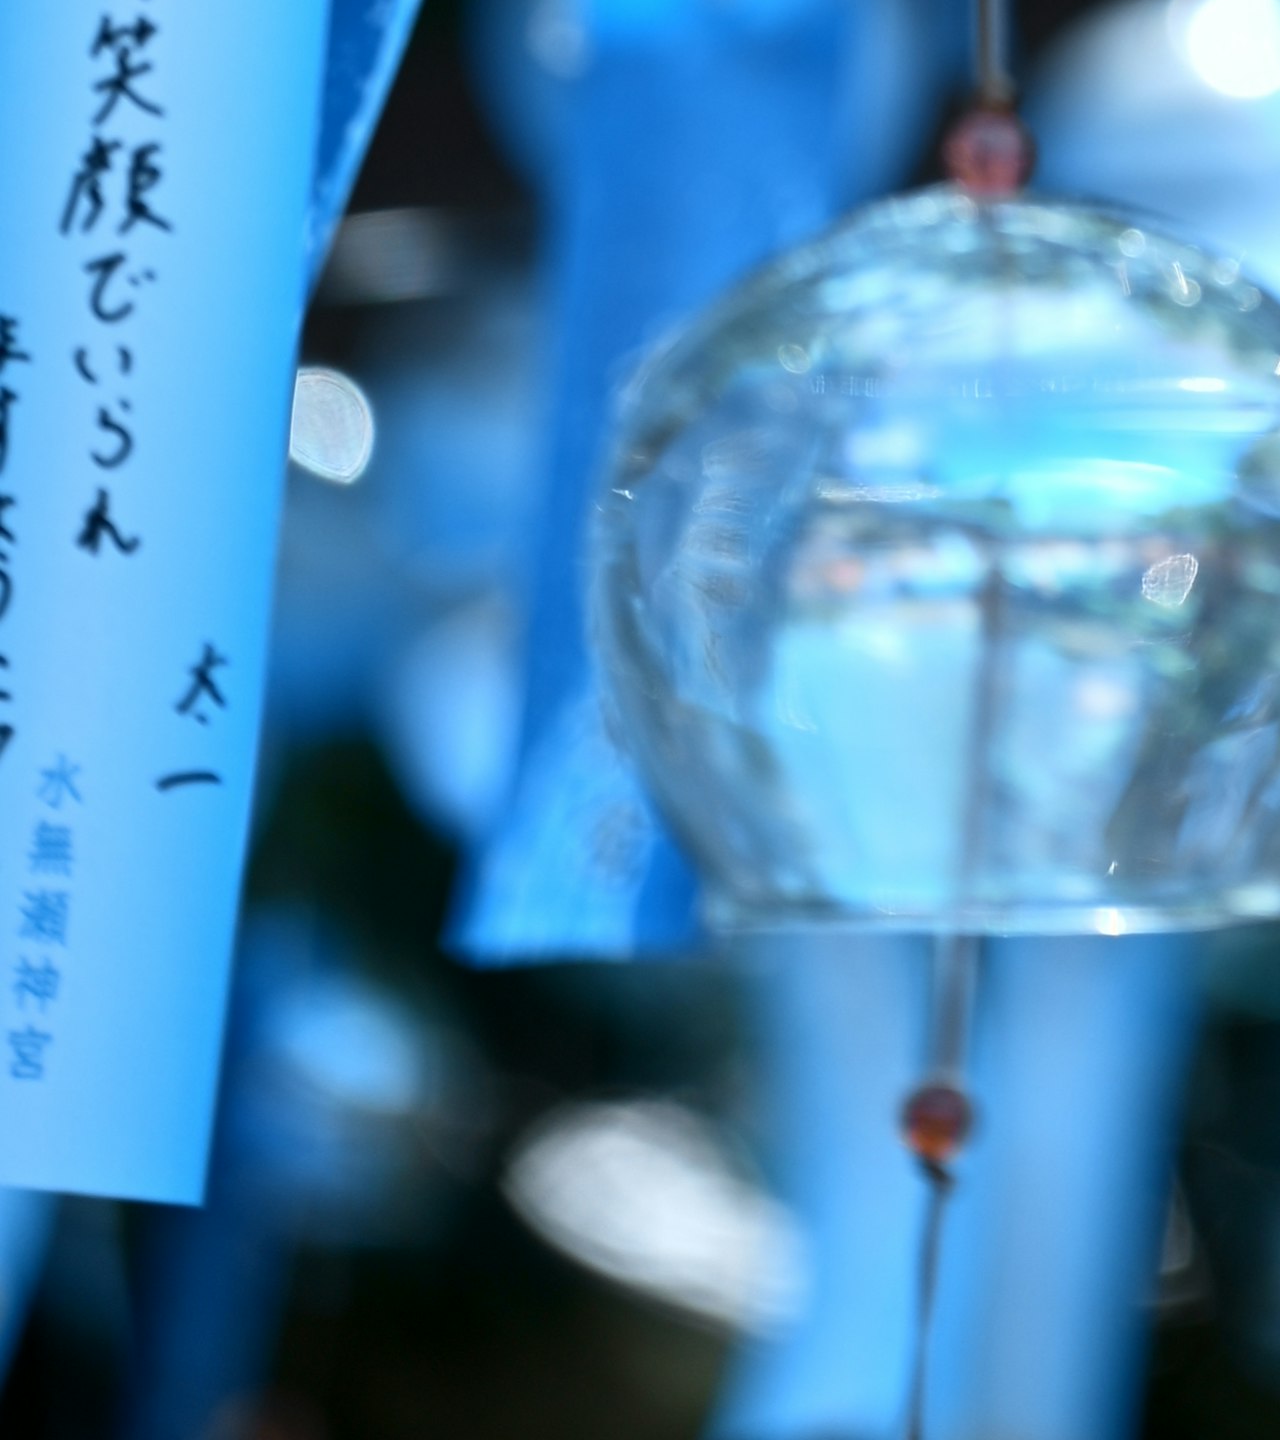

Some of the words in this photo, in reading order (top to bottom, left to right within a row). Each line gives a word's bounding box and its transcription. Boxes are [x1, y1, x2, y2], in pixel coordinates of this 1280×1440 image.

[8, 753, 84, 1081] 水無瀬神宮
